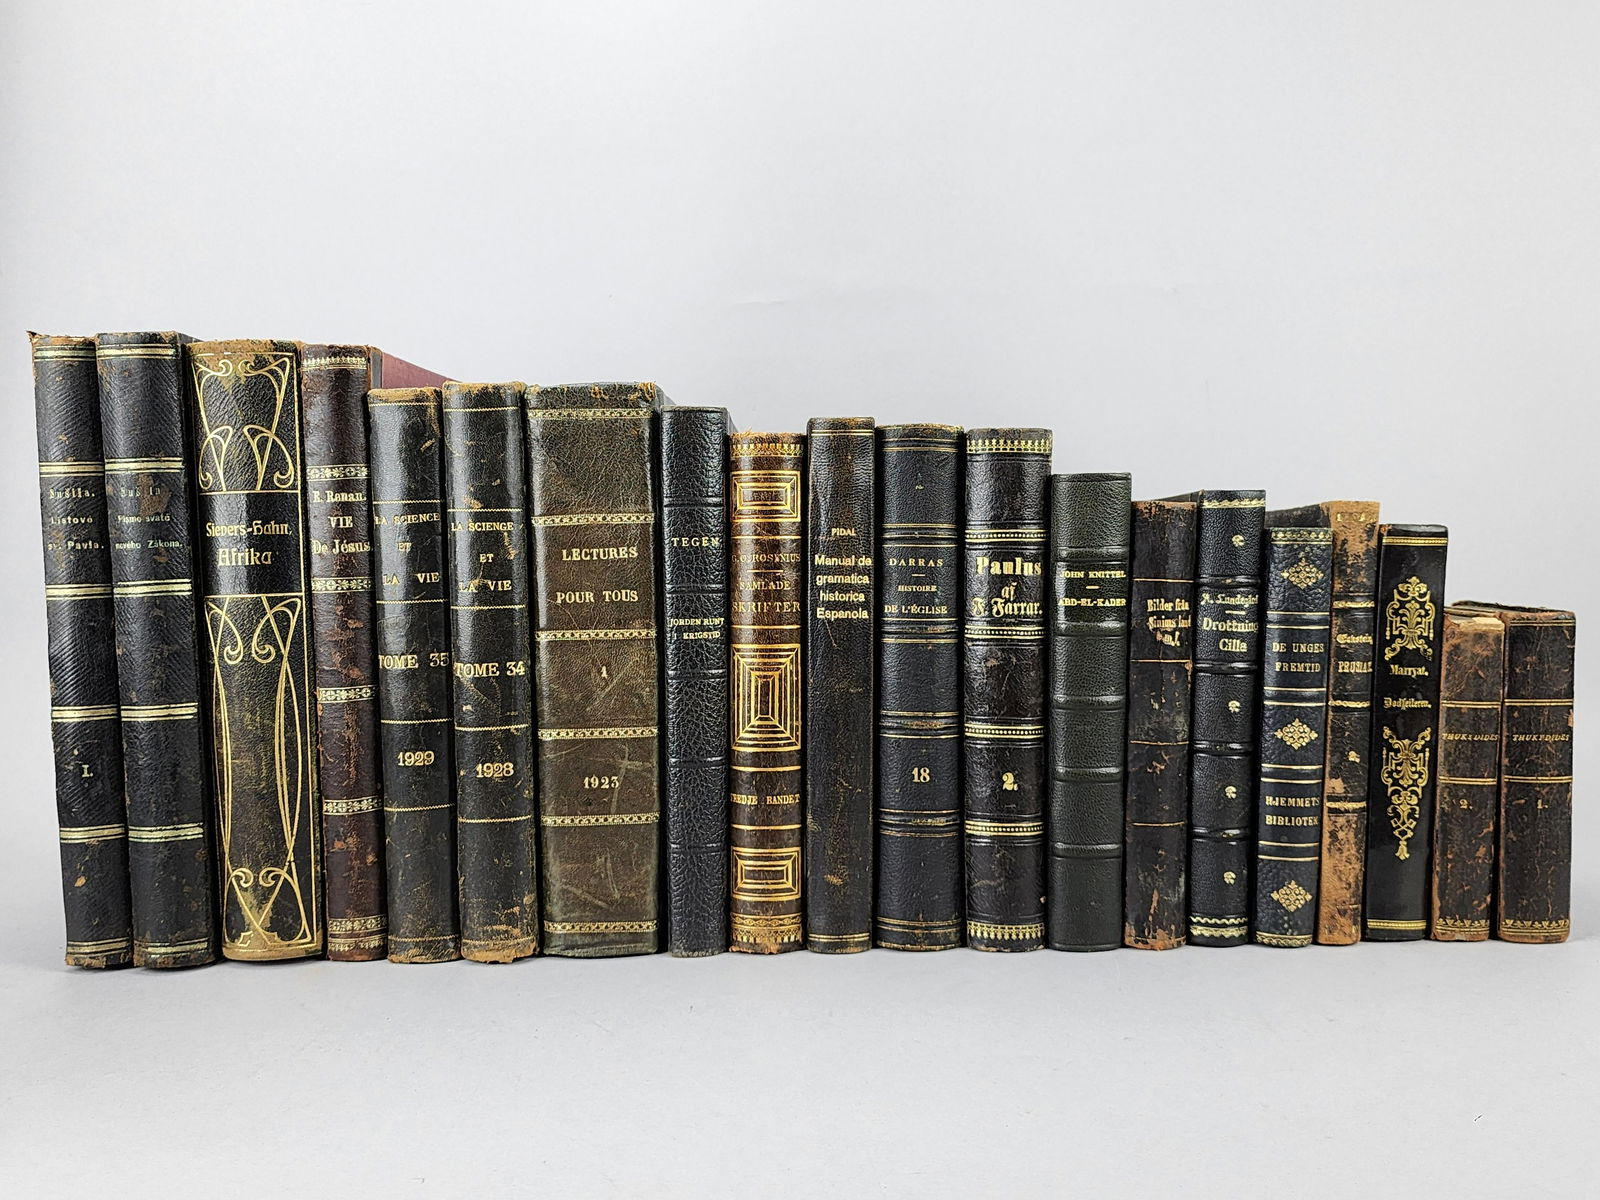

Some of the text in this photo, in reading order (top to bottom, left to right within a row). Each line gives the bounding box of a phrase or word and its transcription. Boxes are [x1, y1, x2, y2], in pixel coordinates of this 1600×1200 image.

[327, 515, 353, 528] VIE
[374, 512, 441, 525] LA SCIENCE
[451, 521, 514, 532] LA SCIENCE
[831, 527, 857, 537] PIDAL
[311, 539, 328, 554] De
[397, 541, 412, 552] ET
[671, 536, 720, 547] TEGEN
[217, 548, 272, 566] Afrika
[479, 553, 494, 563] ET
[562, 546, 638, 561] LECTURES
[814, 554, 873, 566] Manual de
[889, 558, 944, 567] DARRAS
[976, 556, 1042, 576] Paulus
[382, 572, 440, 586] LA VIE
[816, 573, 870, 586] gramatica
[1059, 570, 1127, 579] JOHN KNITTEL
[459, 579, 512, 593] LA VIE
[740, 580, 792, 591] SAMLADE
[1001, 582, 1017, 601] af
[556, 589, 638, 604] POUR TOUS
[819, 590, 866, 602] historica
[1058, 598, 1127, 607] ABD-EL-KADER
[732, 601, 801, 613] SKRIFTER
[884, 603, 948, 614] DE L'ÉGLISE
[971, 597, 1043, 617] F. Farrar.
[1146, 597, 1174, 612] Bilder
[816, 607, 870, 621] Espanola
[670, 617, 725, 627] JORDEN RUNT
[1202, 617, 1258, 632] Drottning
[683, 630, 720, 640] KRIGSTID
[1219, 638, 1247, 652] Cilla
[1272, 642, 1324, 653] DE UNGES
[378, 652, 450, 670] TOME 35
[1274, 661, 1321, 673] FREMTID
[454, 660, 526, 678] TOME 34
[1389, 664, 1429, 679] Marryat.
[397, 750, 435, 767] 1929
[475, 762, 515, 778] 1928
[911, 767, 931, 784] 18
[583, 774, 620, 789] 1923
[766, 793, 801, 805] BANDET
[1265, 795, 1321, 807] HJEMMETS
[1265, 814, 1319, 827] BIBLIOTEK
